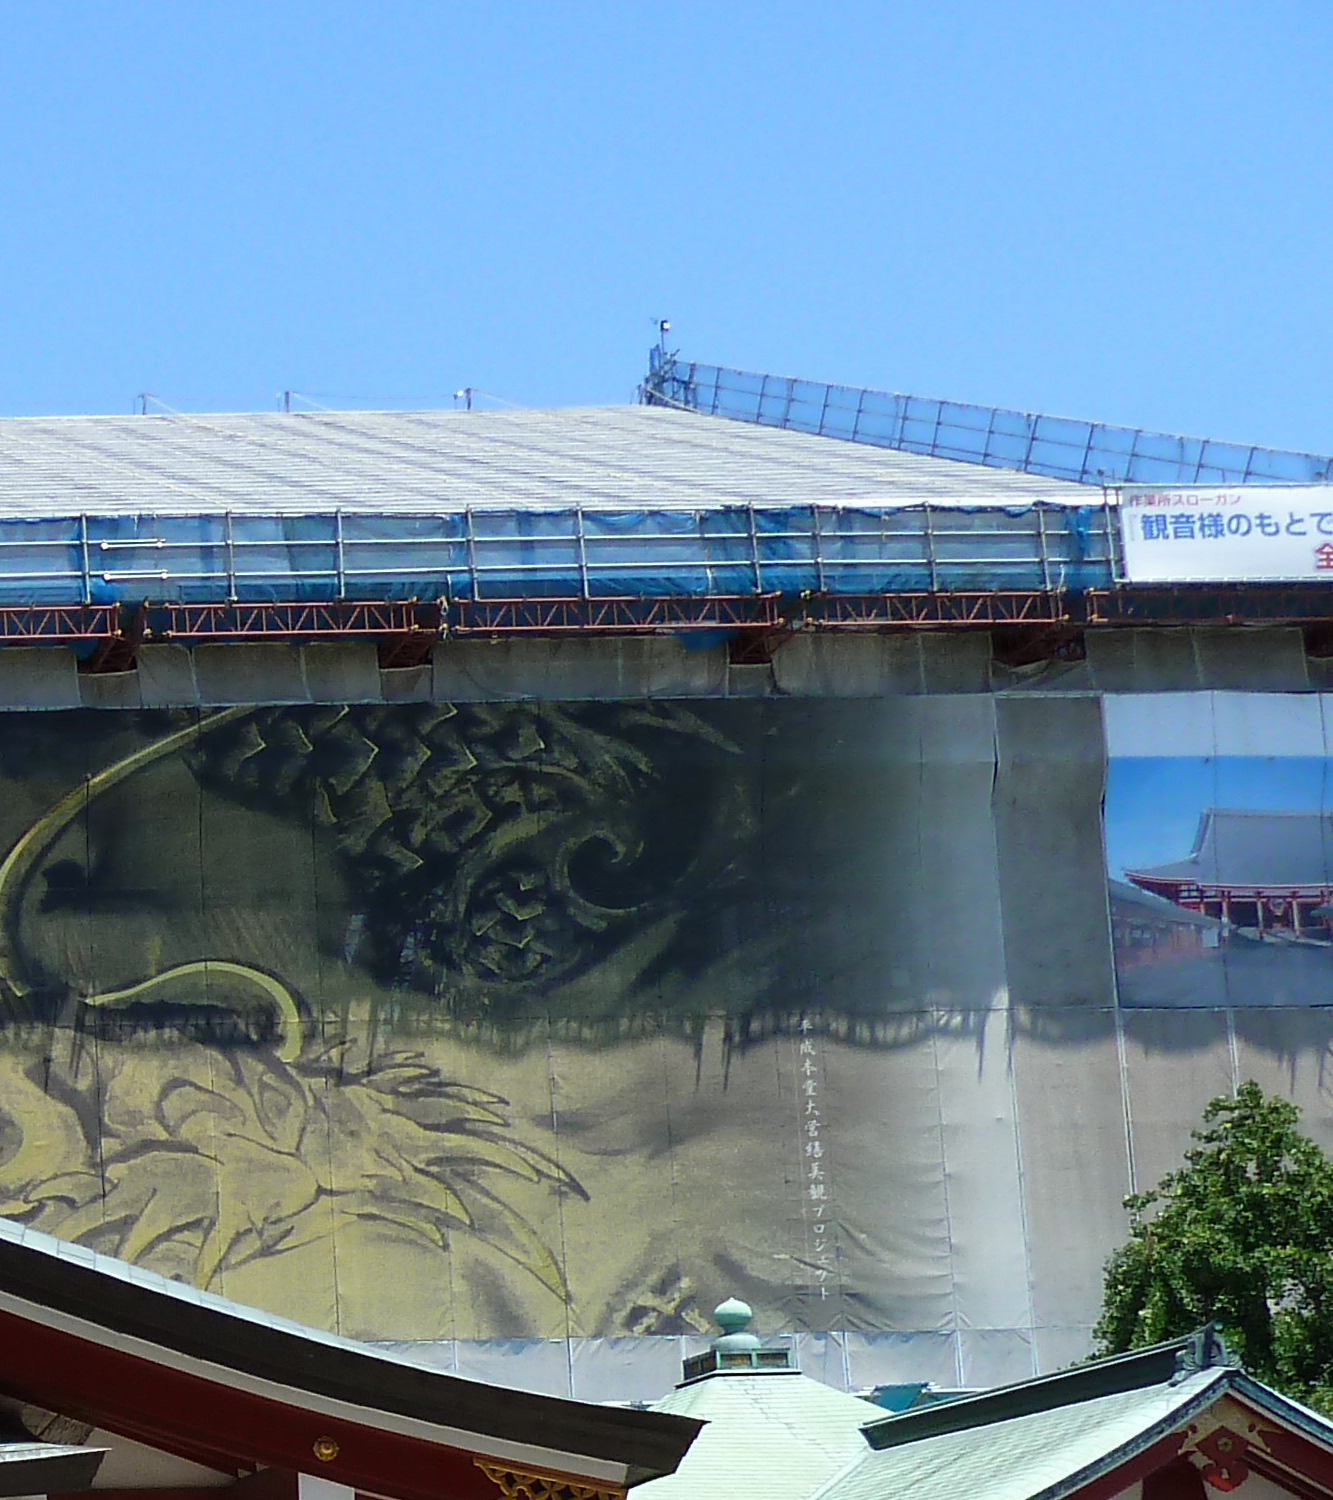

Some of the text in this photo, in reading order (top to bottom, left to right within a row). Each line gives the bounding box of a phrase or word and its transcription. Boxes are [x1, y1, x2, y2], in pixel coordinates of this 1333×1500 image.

[1129, 494, 1241, 507] 作業所スローガン
